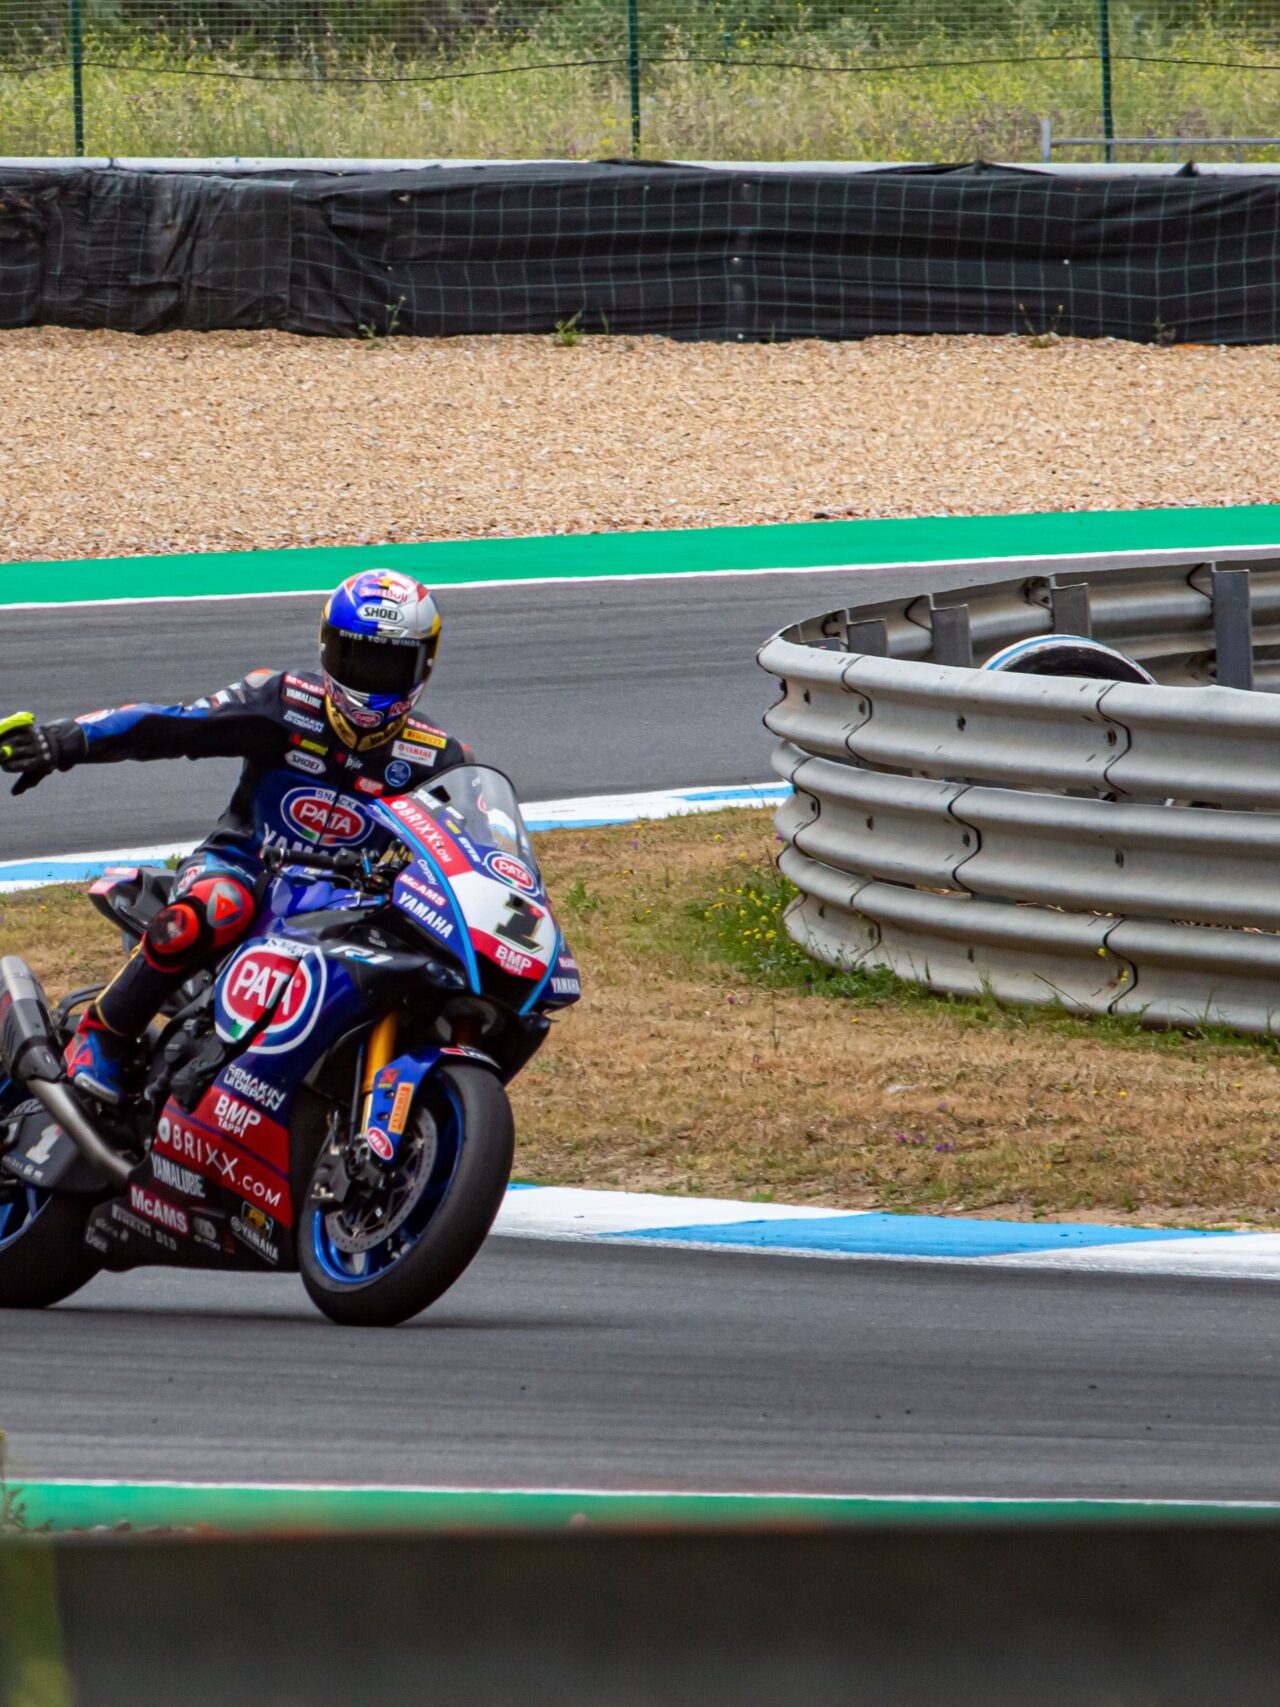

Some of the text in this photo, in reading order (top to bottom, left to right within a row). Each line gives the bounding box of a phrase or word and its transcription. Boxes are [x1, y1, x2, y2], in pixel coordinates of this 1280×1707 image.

[364, 606, 398, 620] SHOEI
[368, 635, 387, 644] YOU
[391, 638, 420, 647] WINGS
[292, 755, 320, 770] SHOEI
[317, 790, 354, 809] SNCK
[299, 802, 353, 834] PATA
[498, 860, 530, 885] PATA
[400, 874, 446, 906] McAMS
[398, 892, 454, 938] YAMAHA
[495, 893, 544, 952] 1
[495, 945, 533, 970] BMP
[228, 1064, 287, 1103] SEMAKIN
[214, 1094, 262, 1129] BMP
[218, 1117, 245, 1138] TAPPI
[24, 1123, 63, 1165] 1
[151, 1152, 206, 1198] YAMALUBE
[131, 1185, 188, 1233] McAMS
[241, 1222, 279, 1261] YAMAHA
